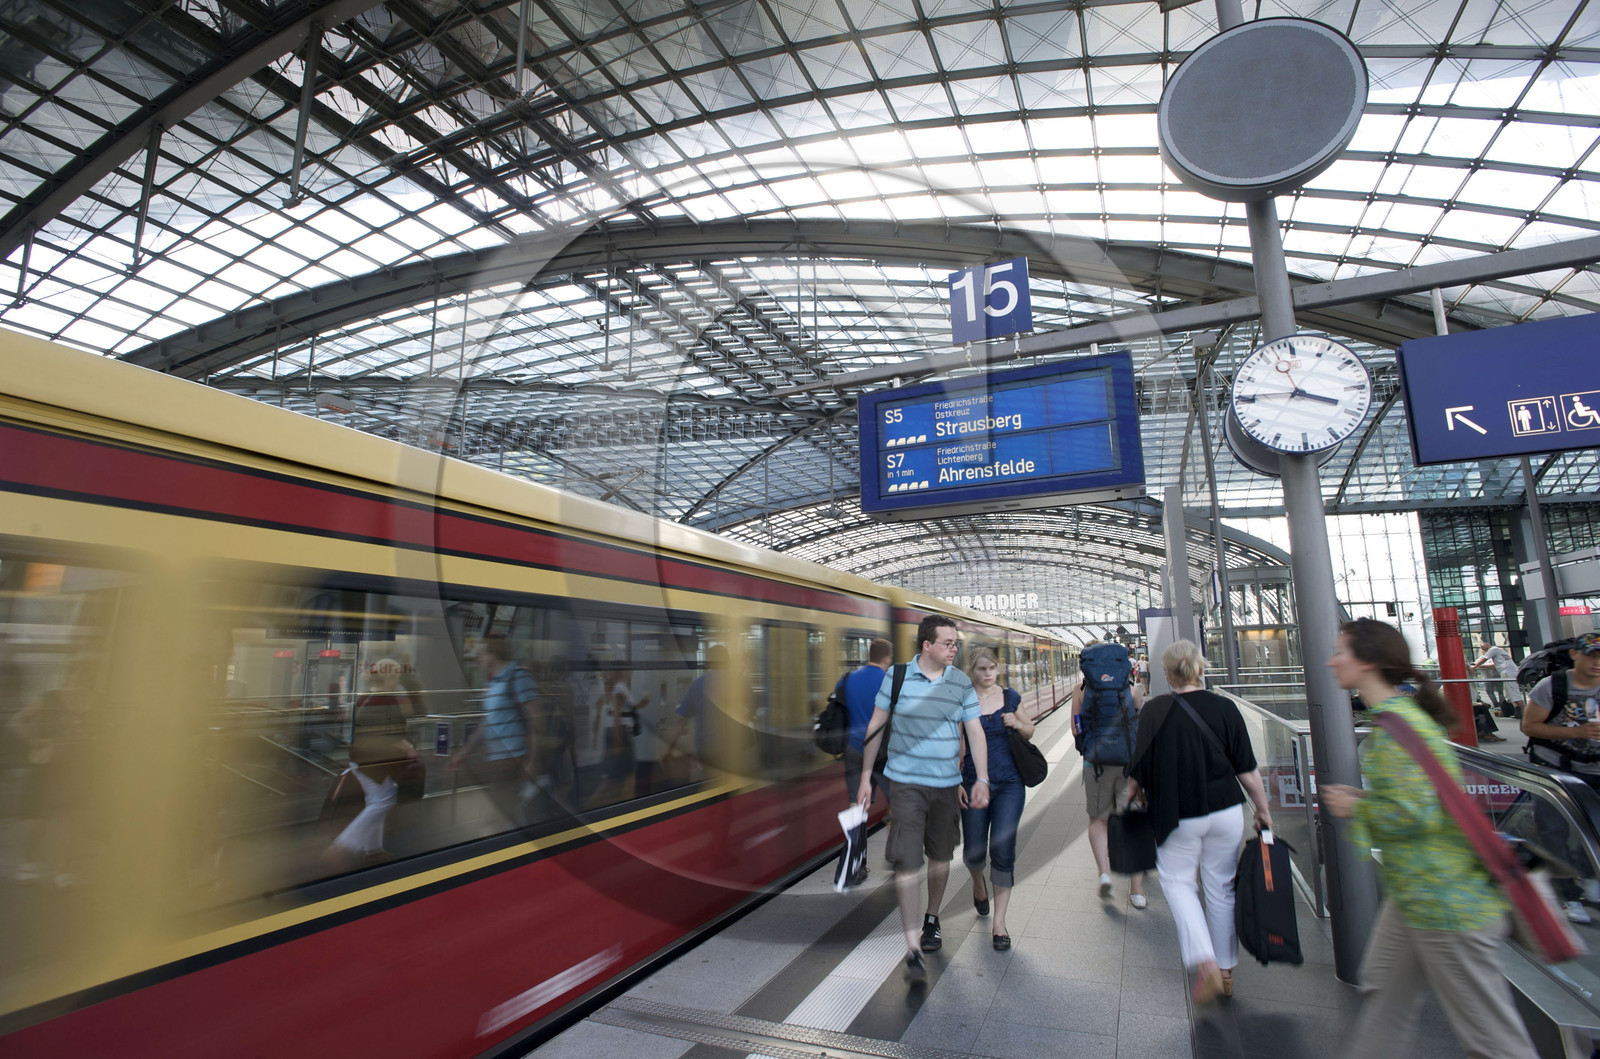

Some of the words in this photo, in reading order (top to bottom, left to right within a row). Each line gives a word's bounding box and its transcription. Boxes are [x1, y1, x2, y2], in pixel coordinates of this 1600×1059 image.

[952, 262, 1019, 322] 15
[934, 395, 994, 410] Friedrichstraße
[885, 408, 903, 424] S5
[935, 408, 971, 420] Ostkreuz
[936, 414, 1022, 437] Strausberg
[937, 441, 997, 456] Friedrichstraße
[886, 453, 905, 469] S7
[937, 453, 983, 466] Lichtenberg
[901, 468, 914, 477] min
[938, 458, 1035, 483] Ahrensfelde
[936, 593, 1039, 610] BARDIER
[1000, 608, 1027, 617] Berlin
